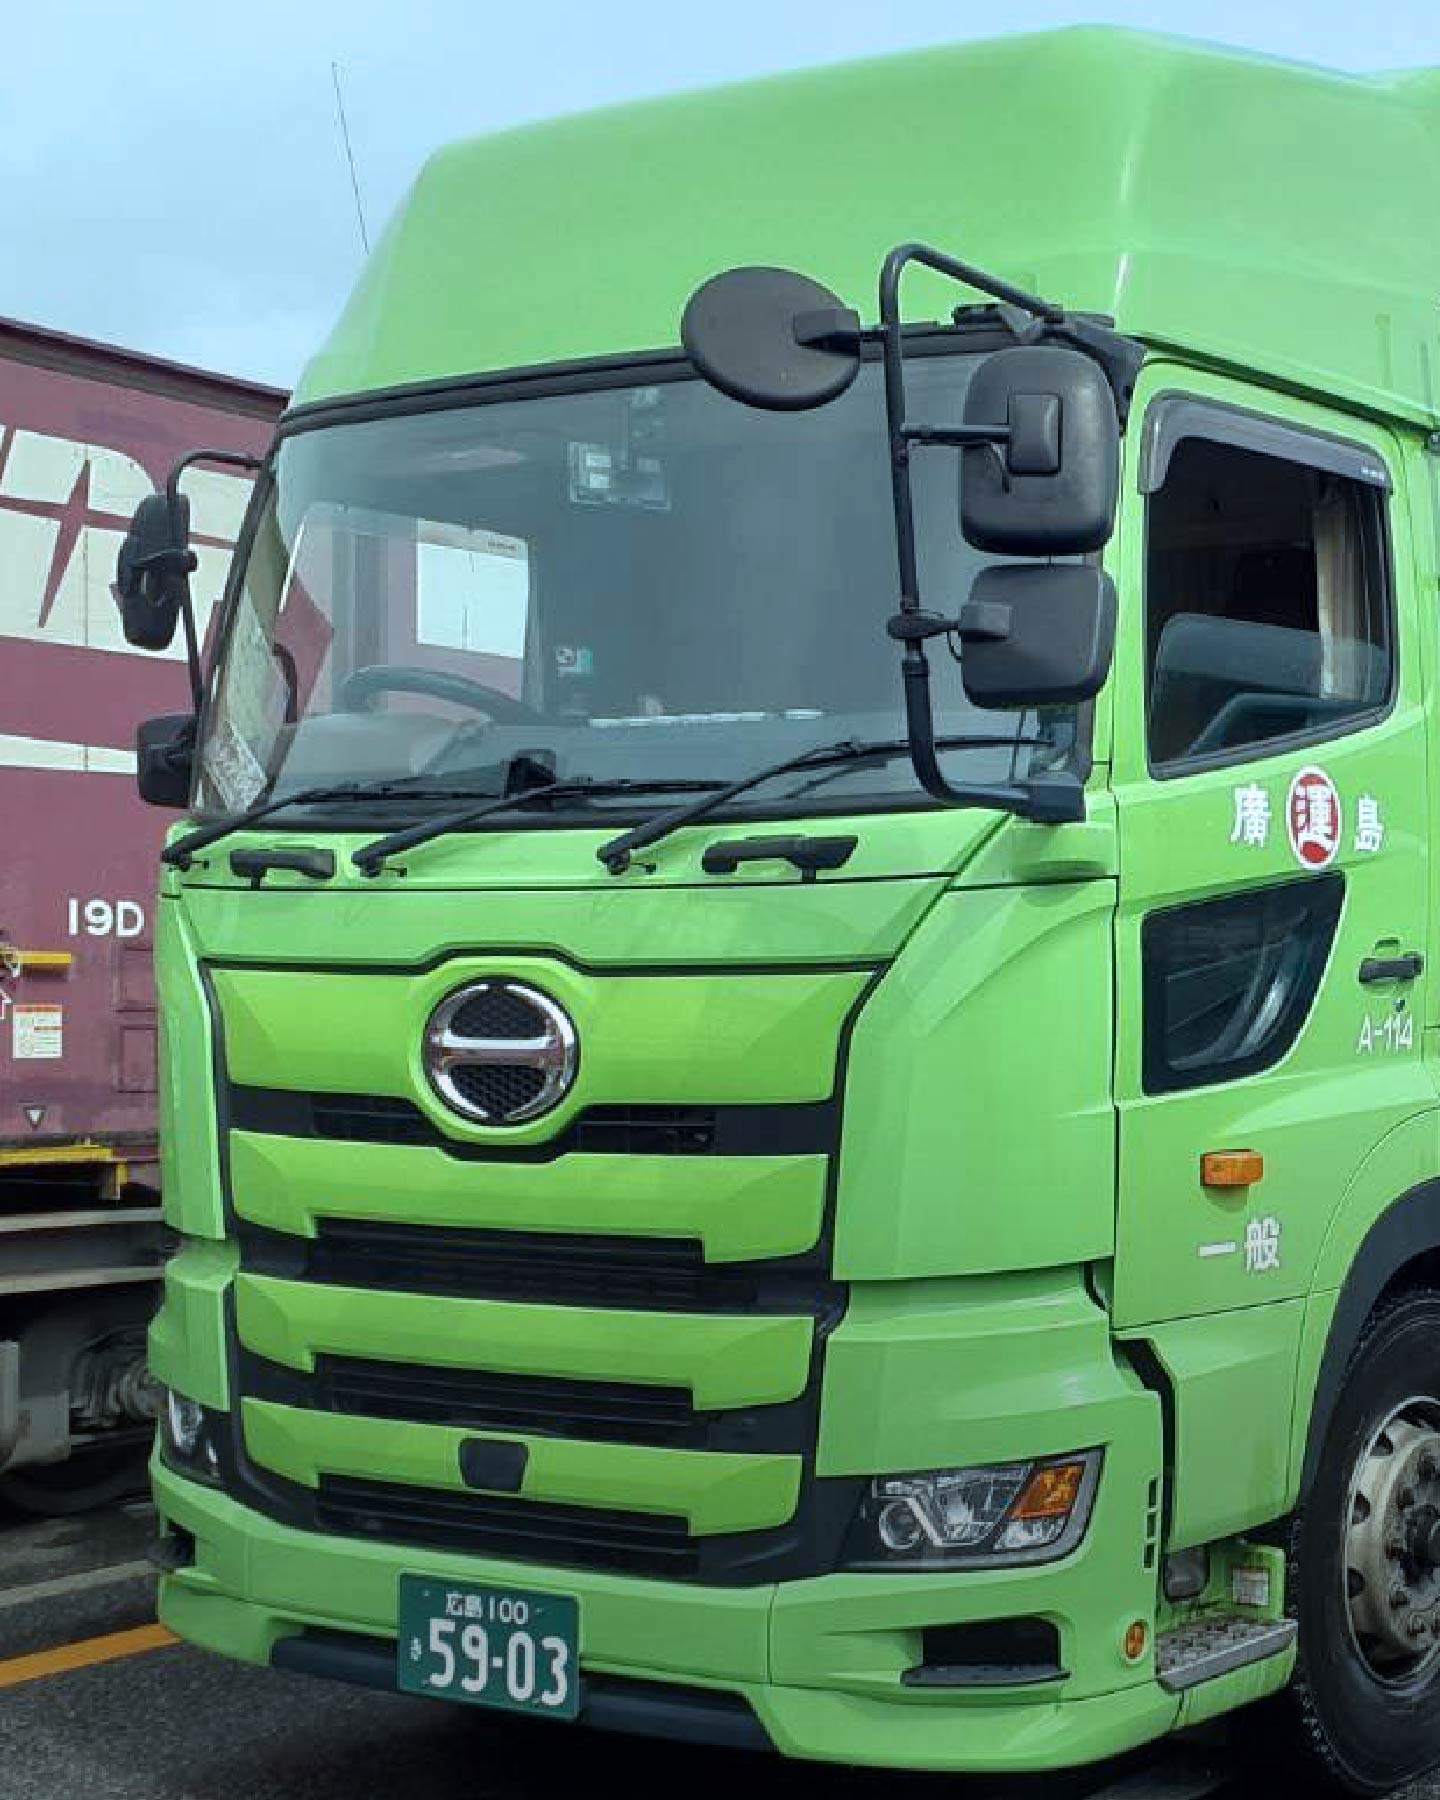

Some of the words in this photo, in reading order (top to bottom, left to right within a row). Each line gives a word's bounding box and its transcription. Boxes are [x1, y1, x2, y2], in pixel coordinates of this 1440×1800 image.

[1355, 793, 1384, 851] 島
[69, 899, 145, 937] 19D
[1357, 1014, 1413, 1054] A-114
[1198, 1216, 1280, 1271] 一般
[446, 1590, 483, 1618] 広島
[489, 1597, 529, 1625] 100
[429, 1618, 568, 1707] 59-03
